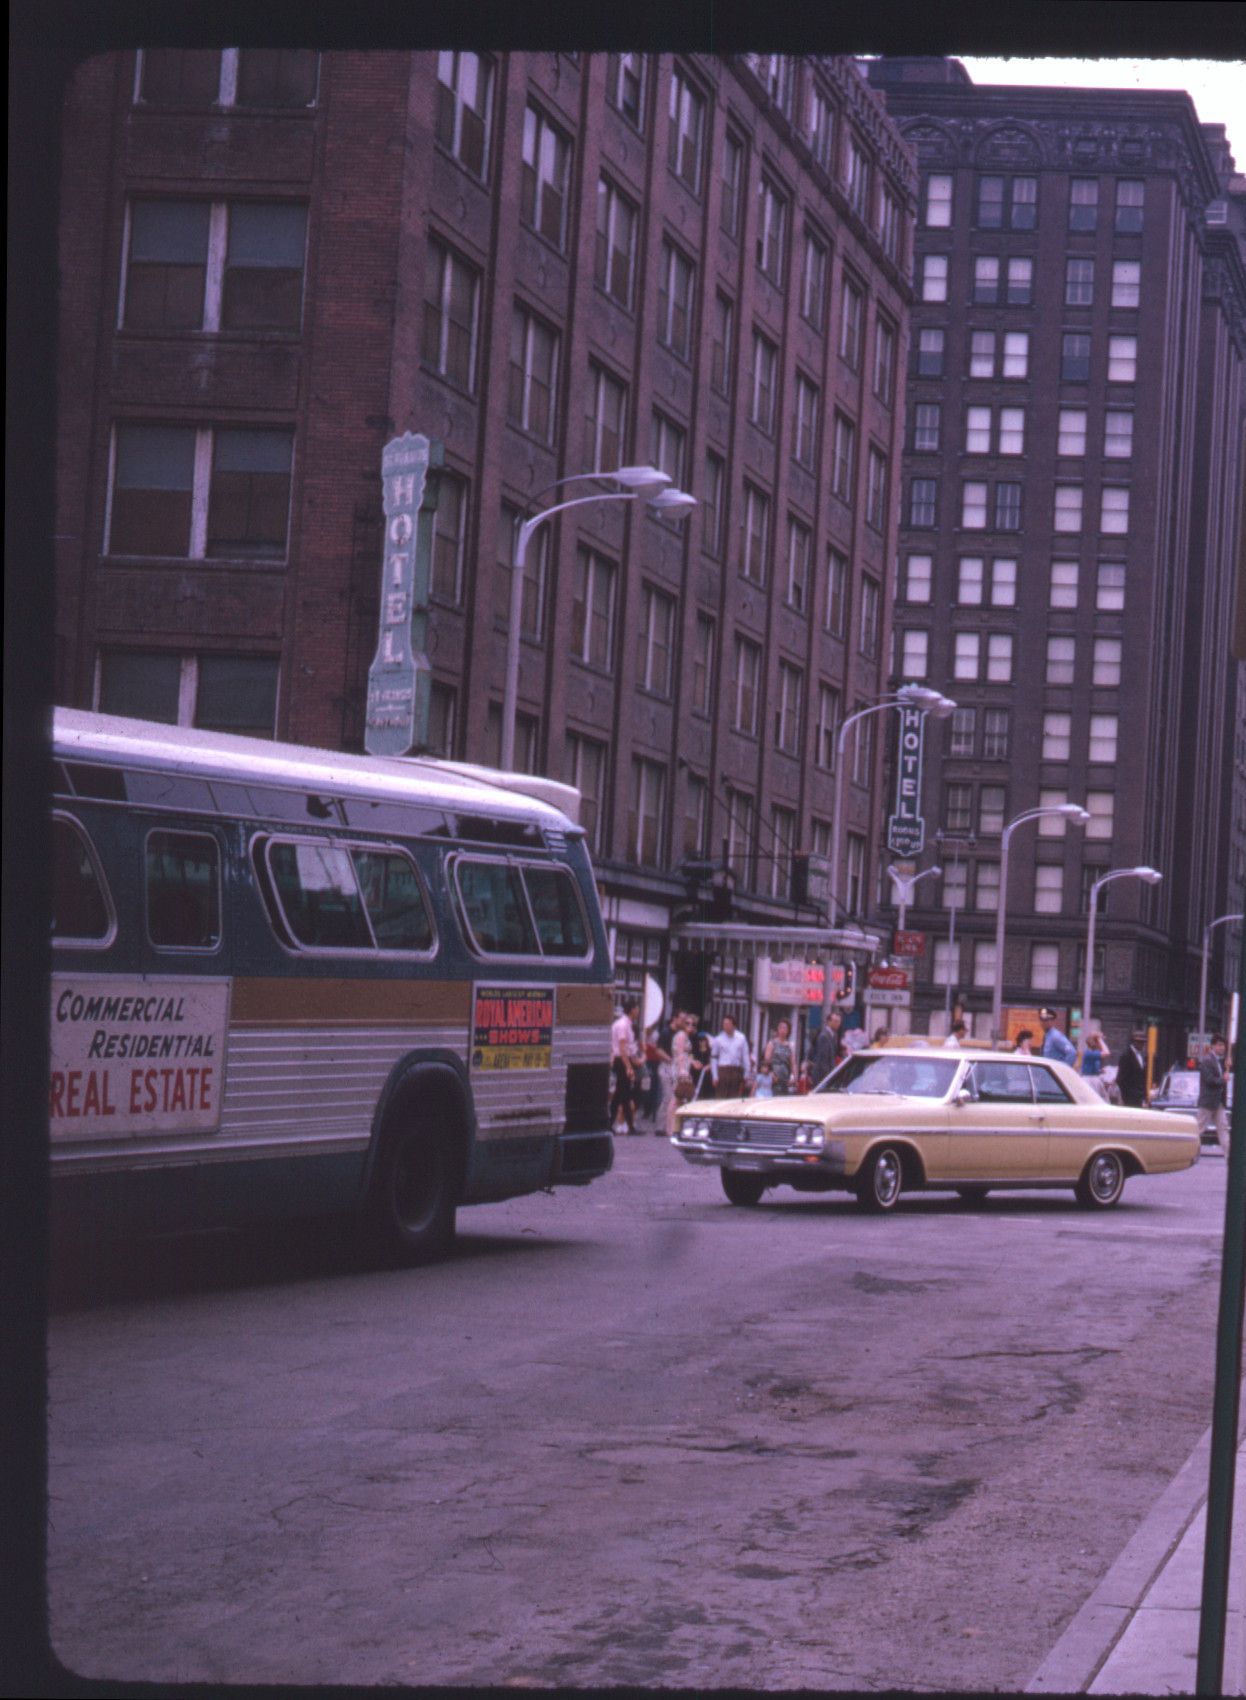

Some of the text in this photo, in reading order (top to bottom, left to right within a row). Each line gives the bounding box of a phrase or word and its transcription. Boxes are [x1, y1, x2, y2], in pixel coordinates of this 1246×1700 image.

[384, 473, 416, 662] HOTEL
[901, 709, 919, 819] HOTEL
[56, 989, 185, 1023] COMMERCIAL
[476, 1000, 553, 1027] ROYAL AMERICAN
[87, 1030, 214, 1058] RESIDENTIAL
[488, 1030, 540, 1045] SHOWS
[50, 1067, 214, 1118] REAL ESTATE
